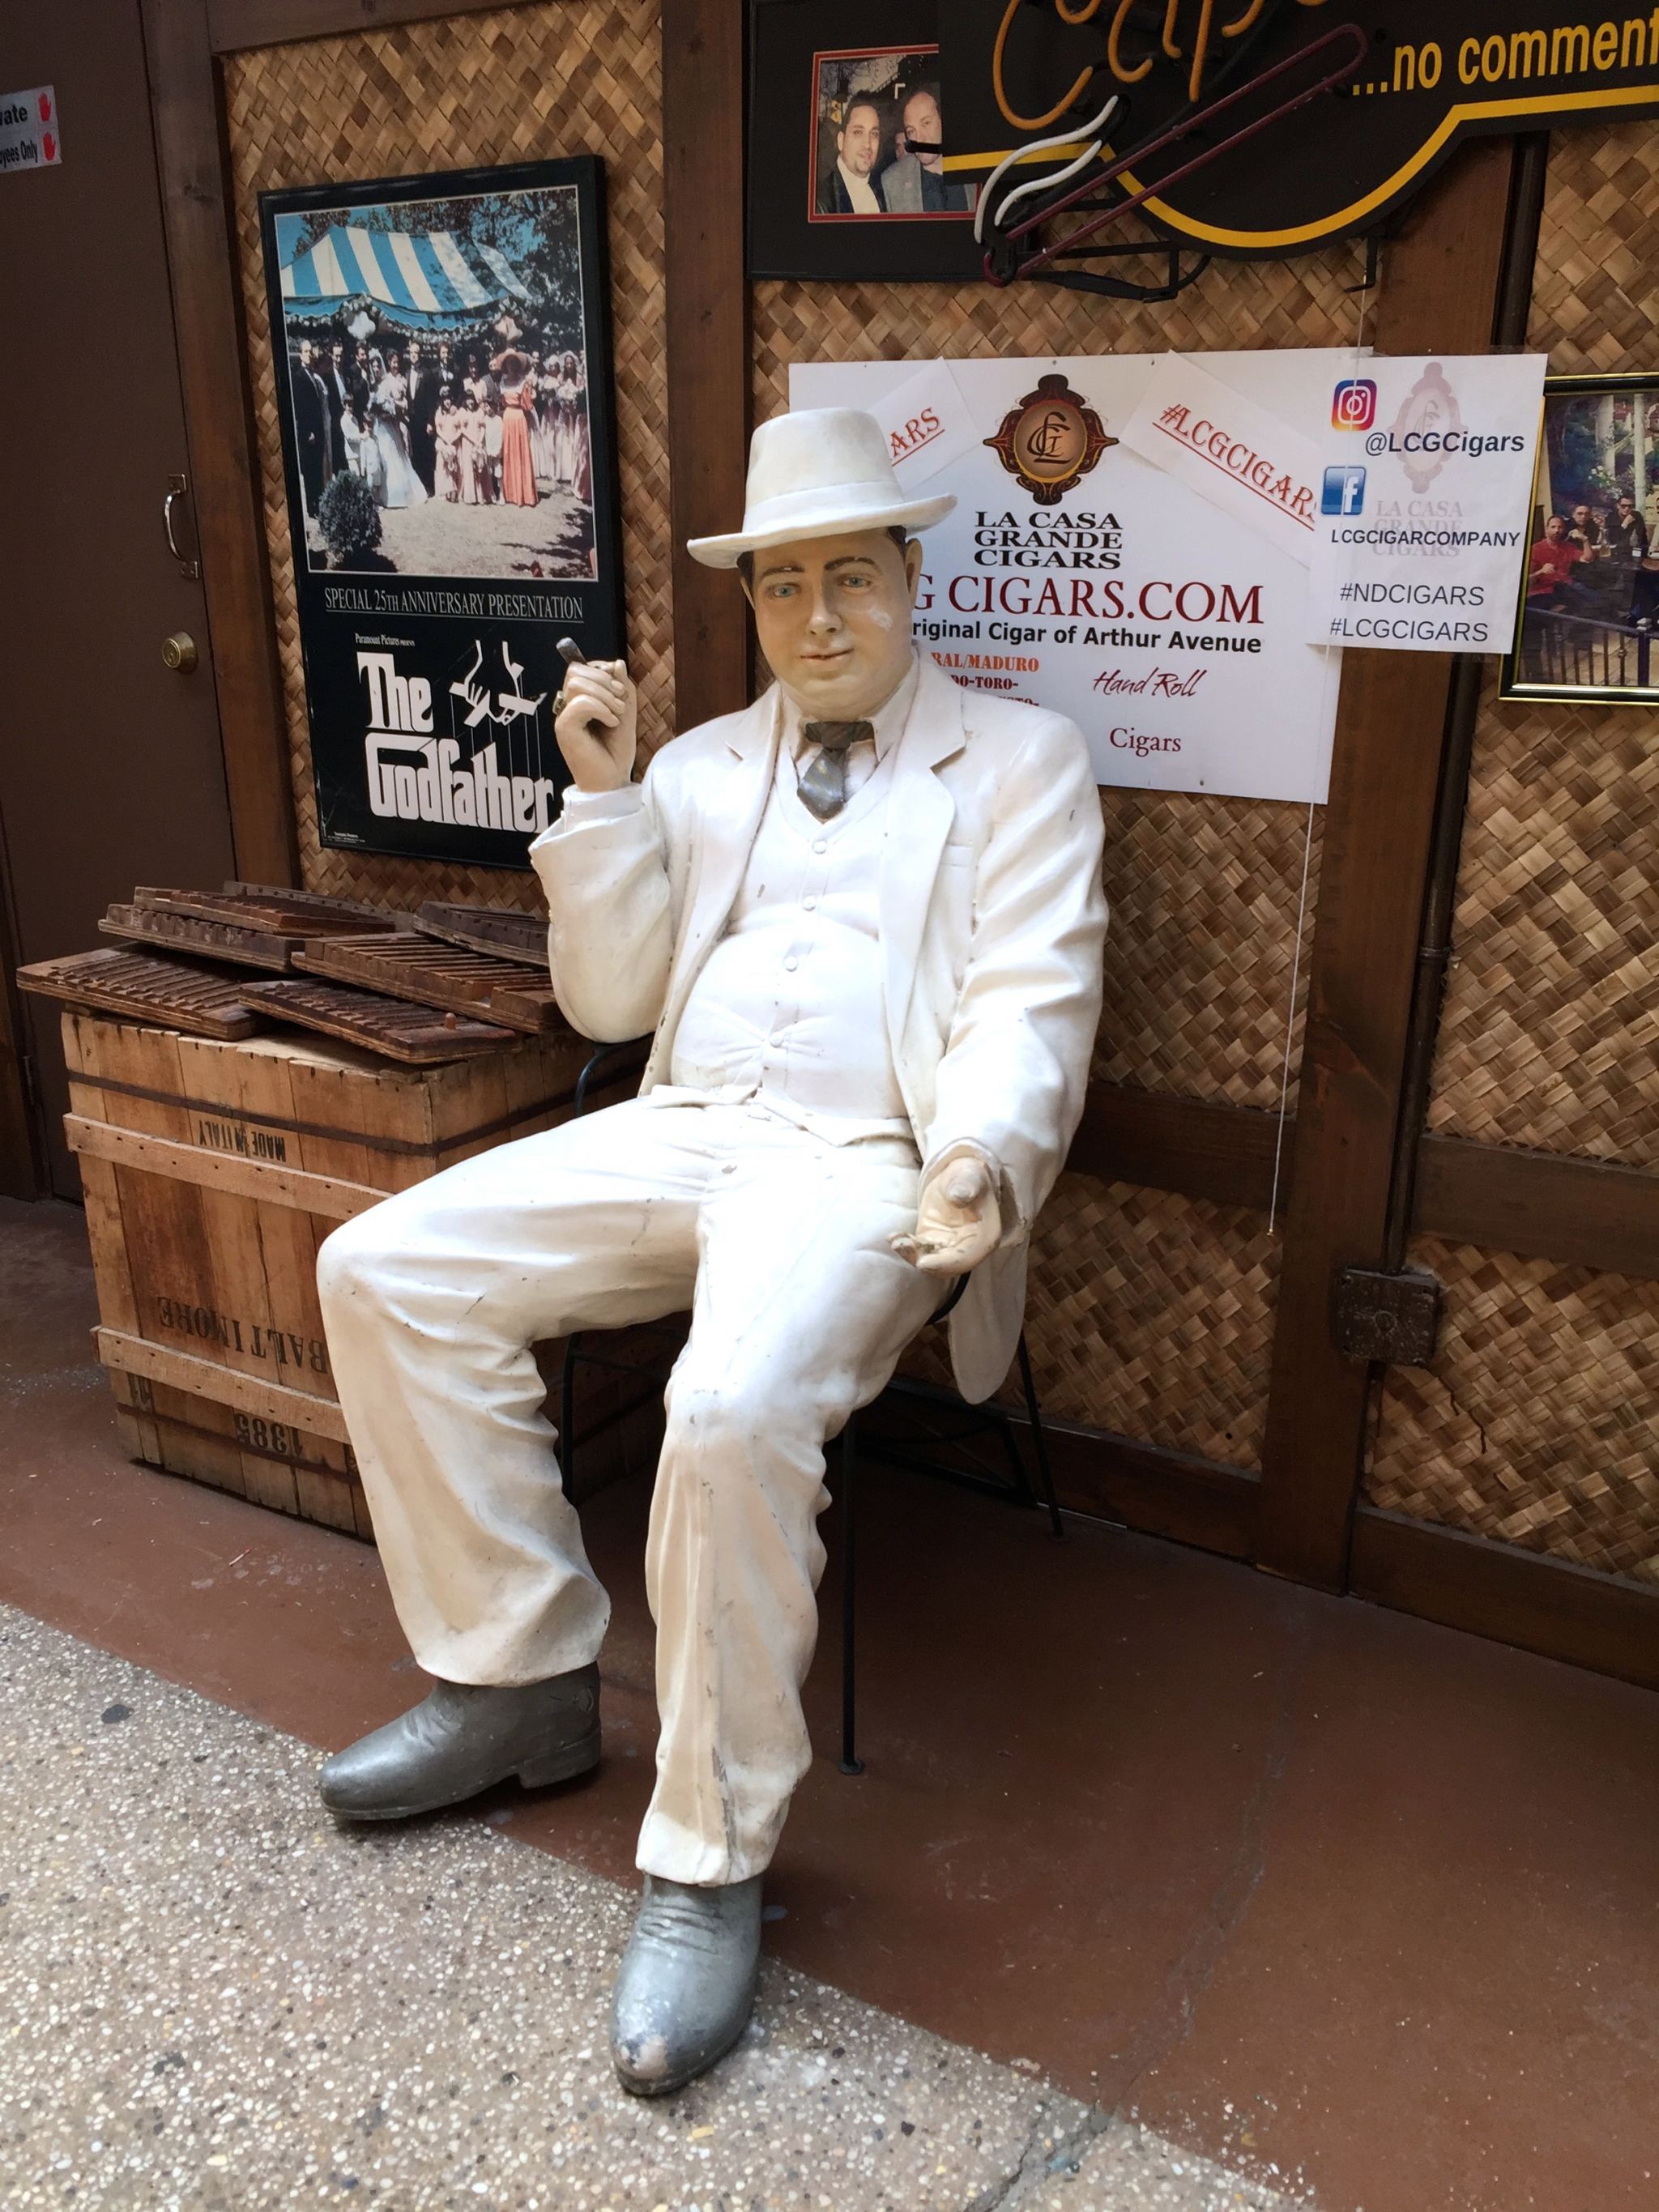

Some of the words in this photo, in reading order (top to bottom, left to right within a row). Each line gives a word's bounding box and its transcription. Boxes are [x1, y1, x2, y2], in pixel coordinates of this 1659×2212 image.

[20, 139, 38, 163] Only
[891, 406, 940, 458] ARS
[1365, 431, 1525, 458] @LCGCigars
[1159, 403, 1317, 523] #LCGCIGAR
[975, 511, 1021, 528] LA
[1028, 511, 1124, 530] CASA
[1408, 500, 1463, 518] CASA
[974, 529, 1123, 550] GRANDE
[1331, 529, 1520, 547] LCGCIGARCOMPANY
[974, 548, 1121, 570] CIGARS
[325, 587, 373, 610] SPECIAL
[374, 589, 399, 612] 25TH
[401, 590, 485, 616] ANNIVERSARY
[488, 592, 583, 620] PRESENTATION
[914, 573, 936, 611] G
[949, 574, 1265, 624] CIGARS.COM
[1340, 582, 1485, 607] #NDCIGARS
[912, 618, 980, 641] riginal
[988, 622, 1047, 646] Cigar
[1054, 625, 1077, 644] of
[1082, 627, 1162, 649] Arthur
[1168, 631, 1262, 654] Avenue
[1329, 618, 1489, 642] #LCGCIGARS
[931, 651, 1040, 673] RAL/MADURO
[356, 651, 434, 733] The
[950, 674, 1019, 691] DO-TORO-
[1093, 667, 1160, 696] Hand
[1150, 669, 1208, 698] Roll
[1109, 727, 1182, 758] Cigars
[365, 732, 556, 834] Godfather
[198, 1120, 233, 1150] ITALY
[251, 1131, 286, 1162] MADE
[157, 1296, 328, 1375] BALTIMORE
